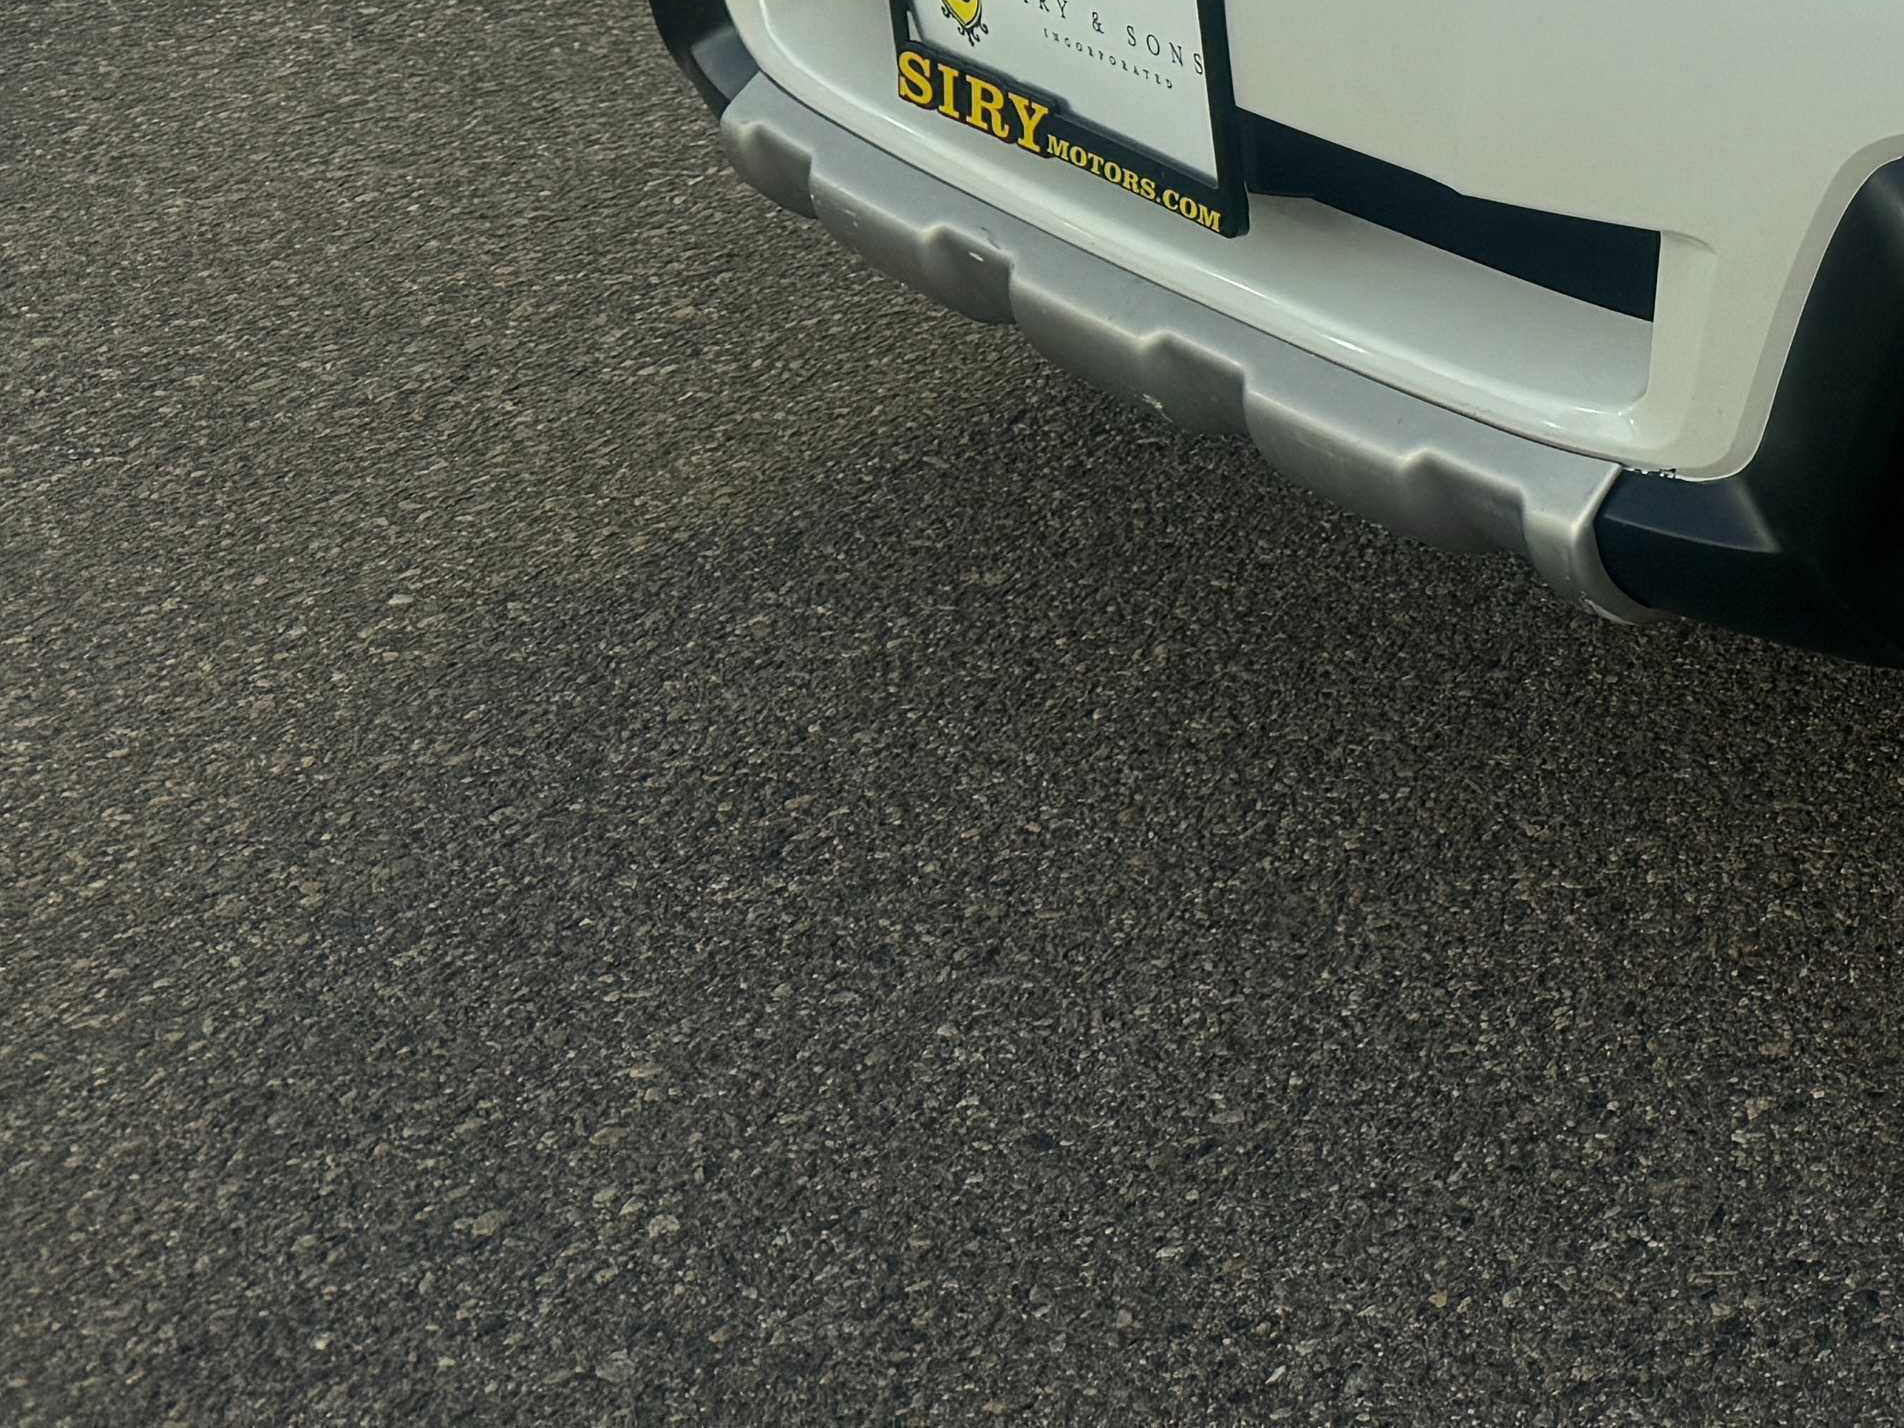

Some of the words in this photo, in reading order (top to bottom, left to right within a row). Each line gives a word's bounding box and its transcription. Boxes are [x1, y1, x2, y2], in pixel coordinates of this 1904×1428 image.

[1043, 27, 1174, 89] INCORPORATED
[1091, 11, 1105, 34] &
[1126, 24, 1204, 75] SONS
[898, 49, 1049, 154] SIRY
[1048, 133, 1222, 232] MOTORS.COM
